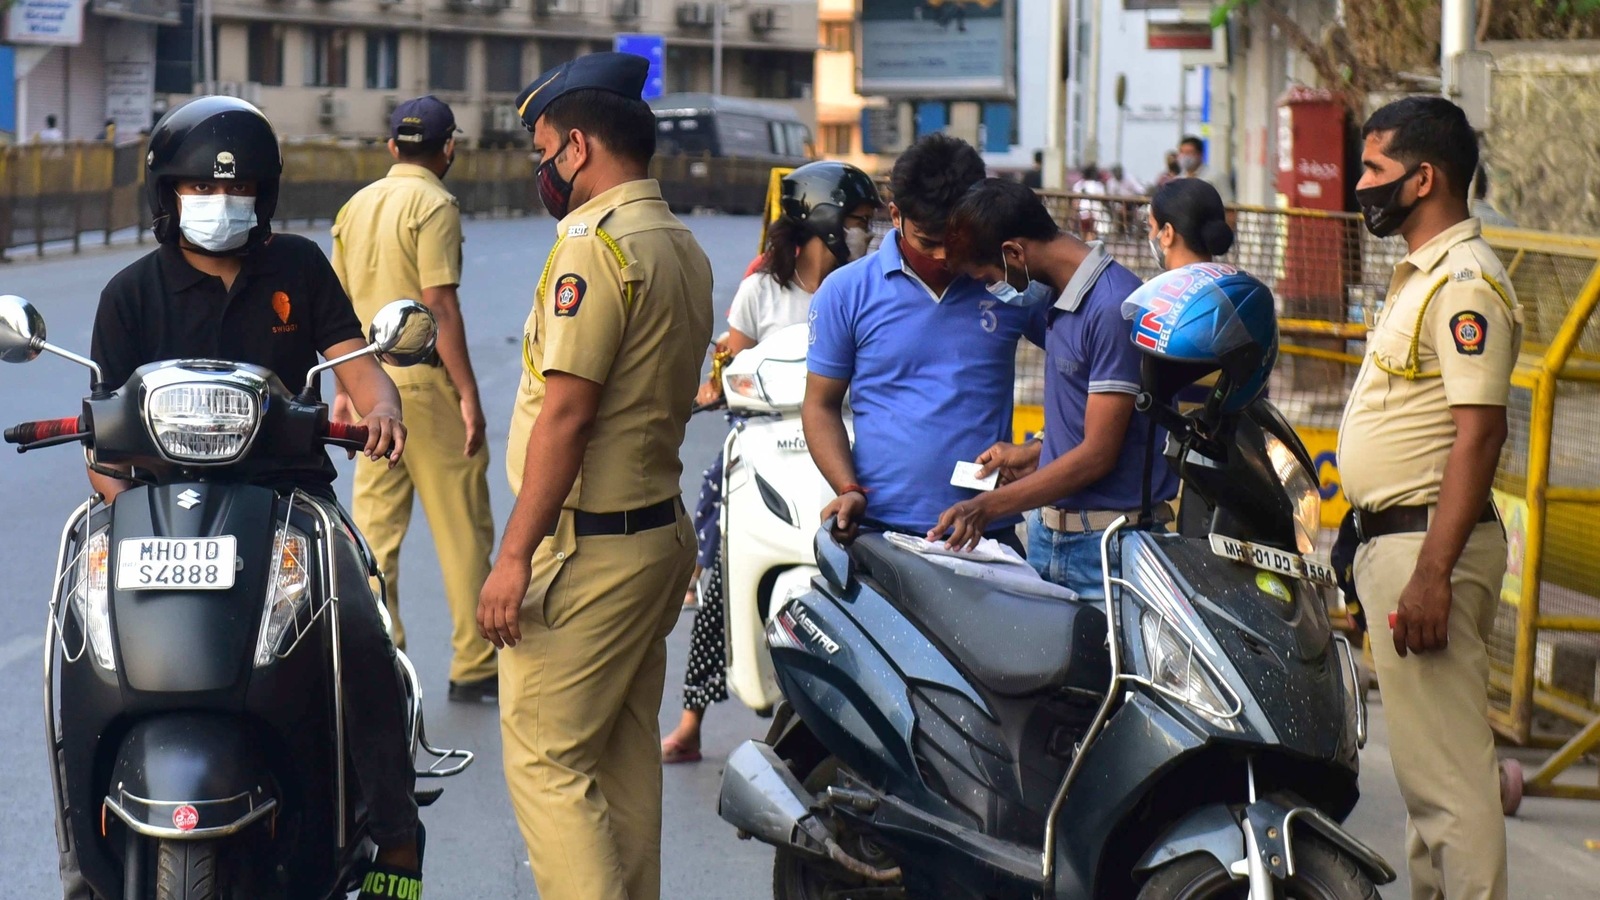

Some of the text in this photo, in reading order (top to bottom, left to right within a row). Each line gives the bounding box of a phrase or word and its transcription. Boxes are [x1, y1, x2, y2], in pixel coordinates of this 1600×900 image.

[979, 300, 998, 333] 3
[1157, 328, 1172, 354] FEEL
[1166, 300, 1185, 326] LIKE
[1182, 294, 1192, 303] A
[139, 564, 218, 585] S4888
[789, 599, 840, 655] MAESTRO
